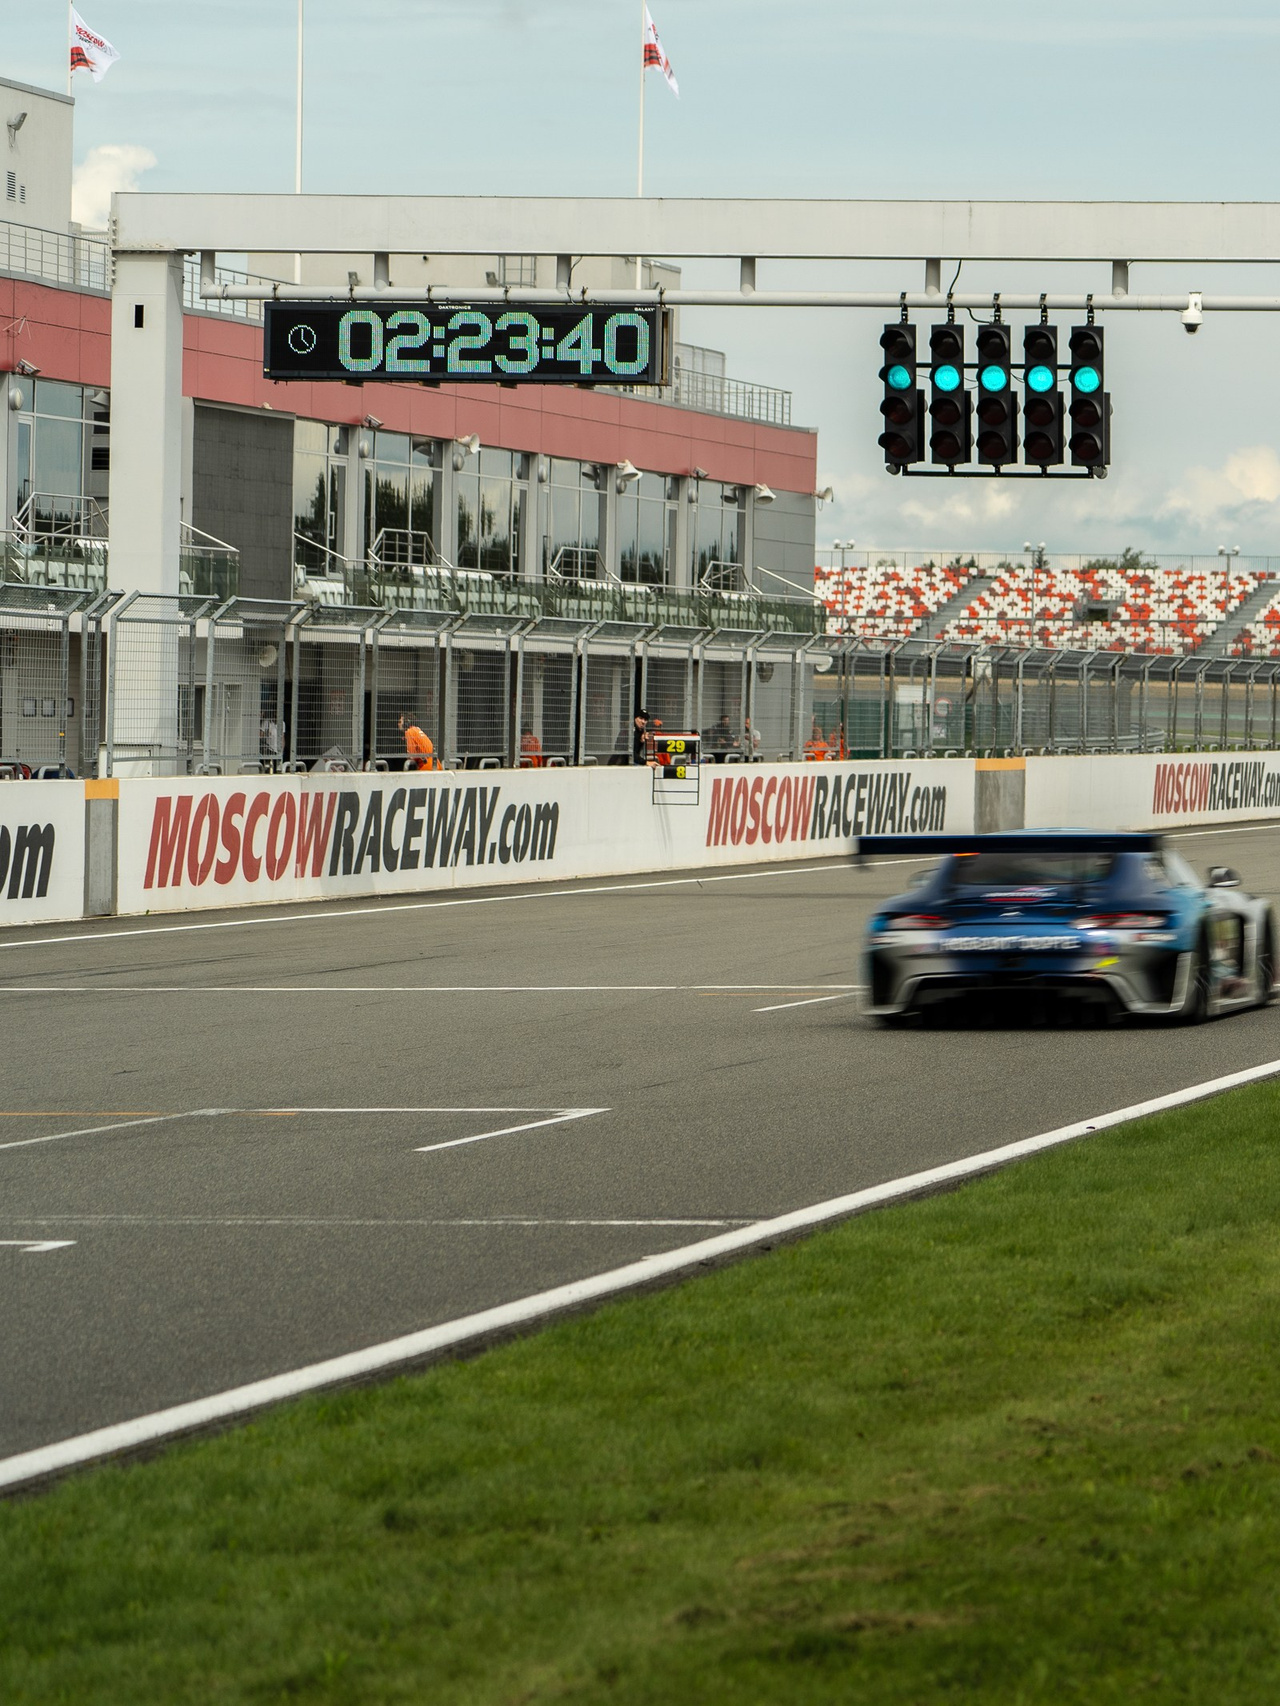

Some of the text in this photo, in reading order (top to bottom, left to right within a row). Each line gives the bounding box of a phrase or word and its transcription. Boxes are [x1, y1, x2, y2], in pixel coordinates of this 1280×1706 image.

[338, 310, 650, 375] 02:23:40
[666, 740, 686, 753] 29
[676, 766, 686, 779] 8
[143, 786, 560, 890] MOSCOWRACEWAY.com
